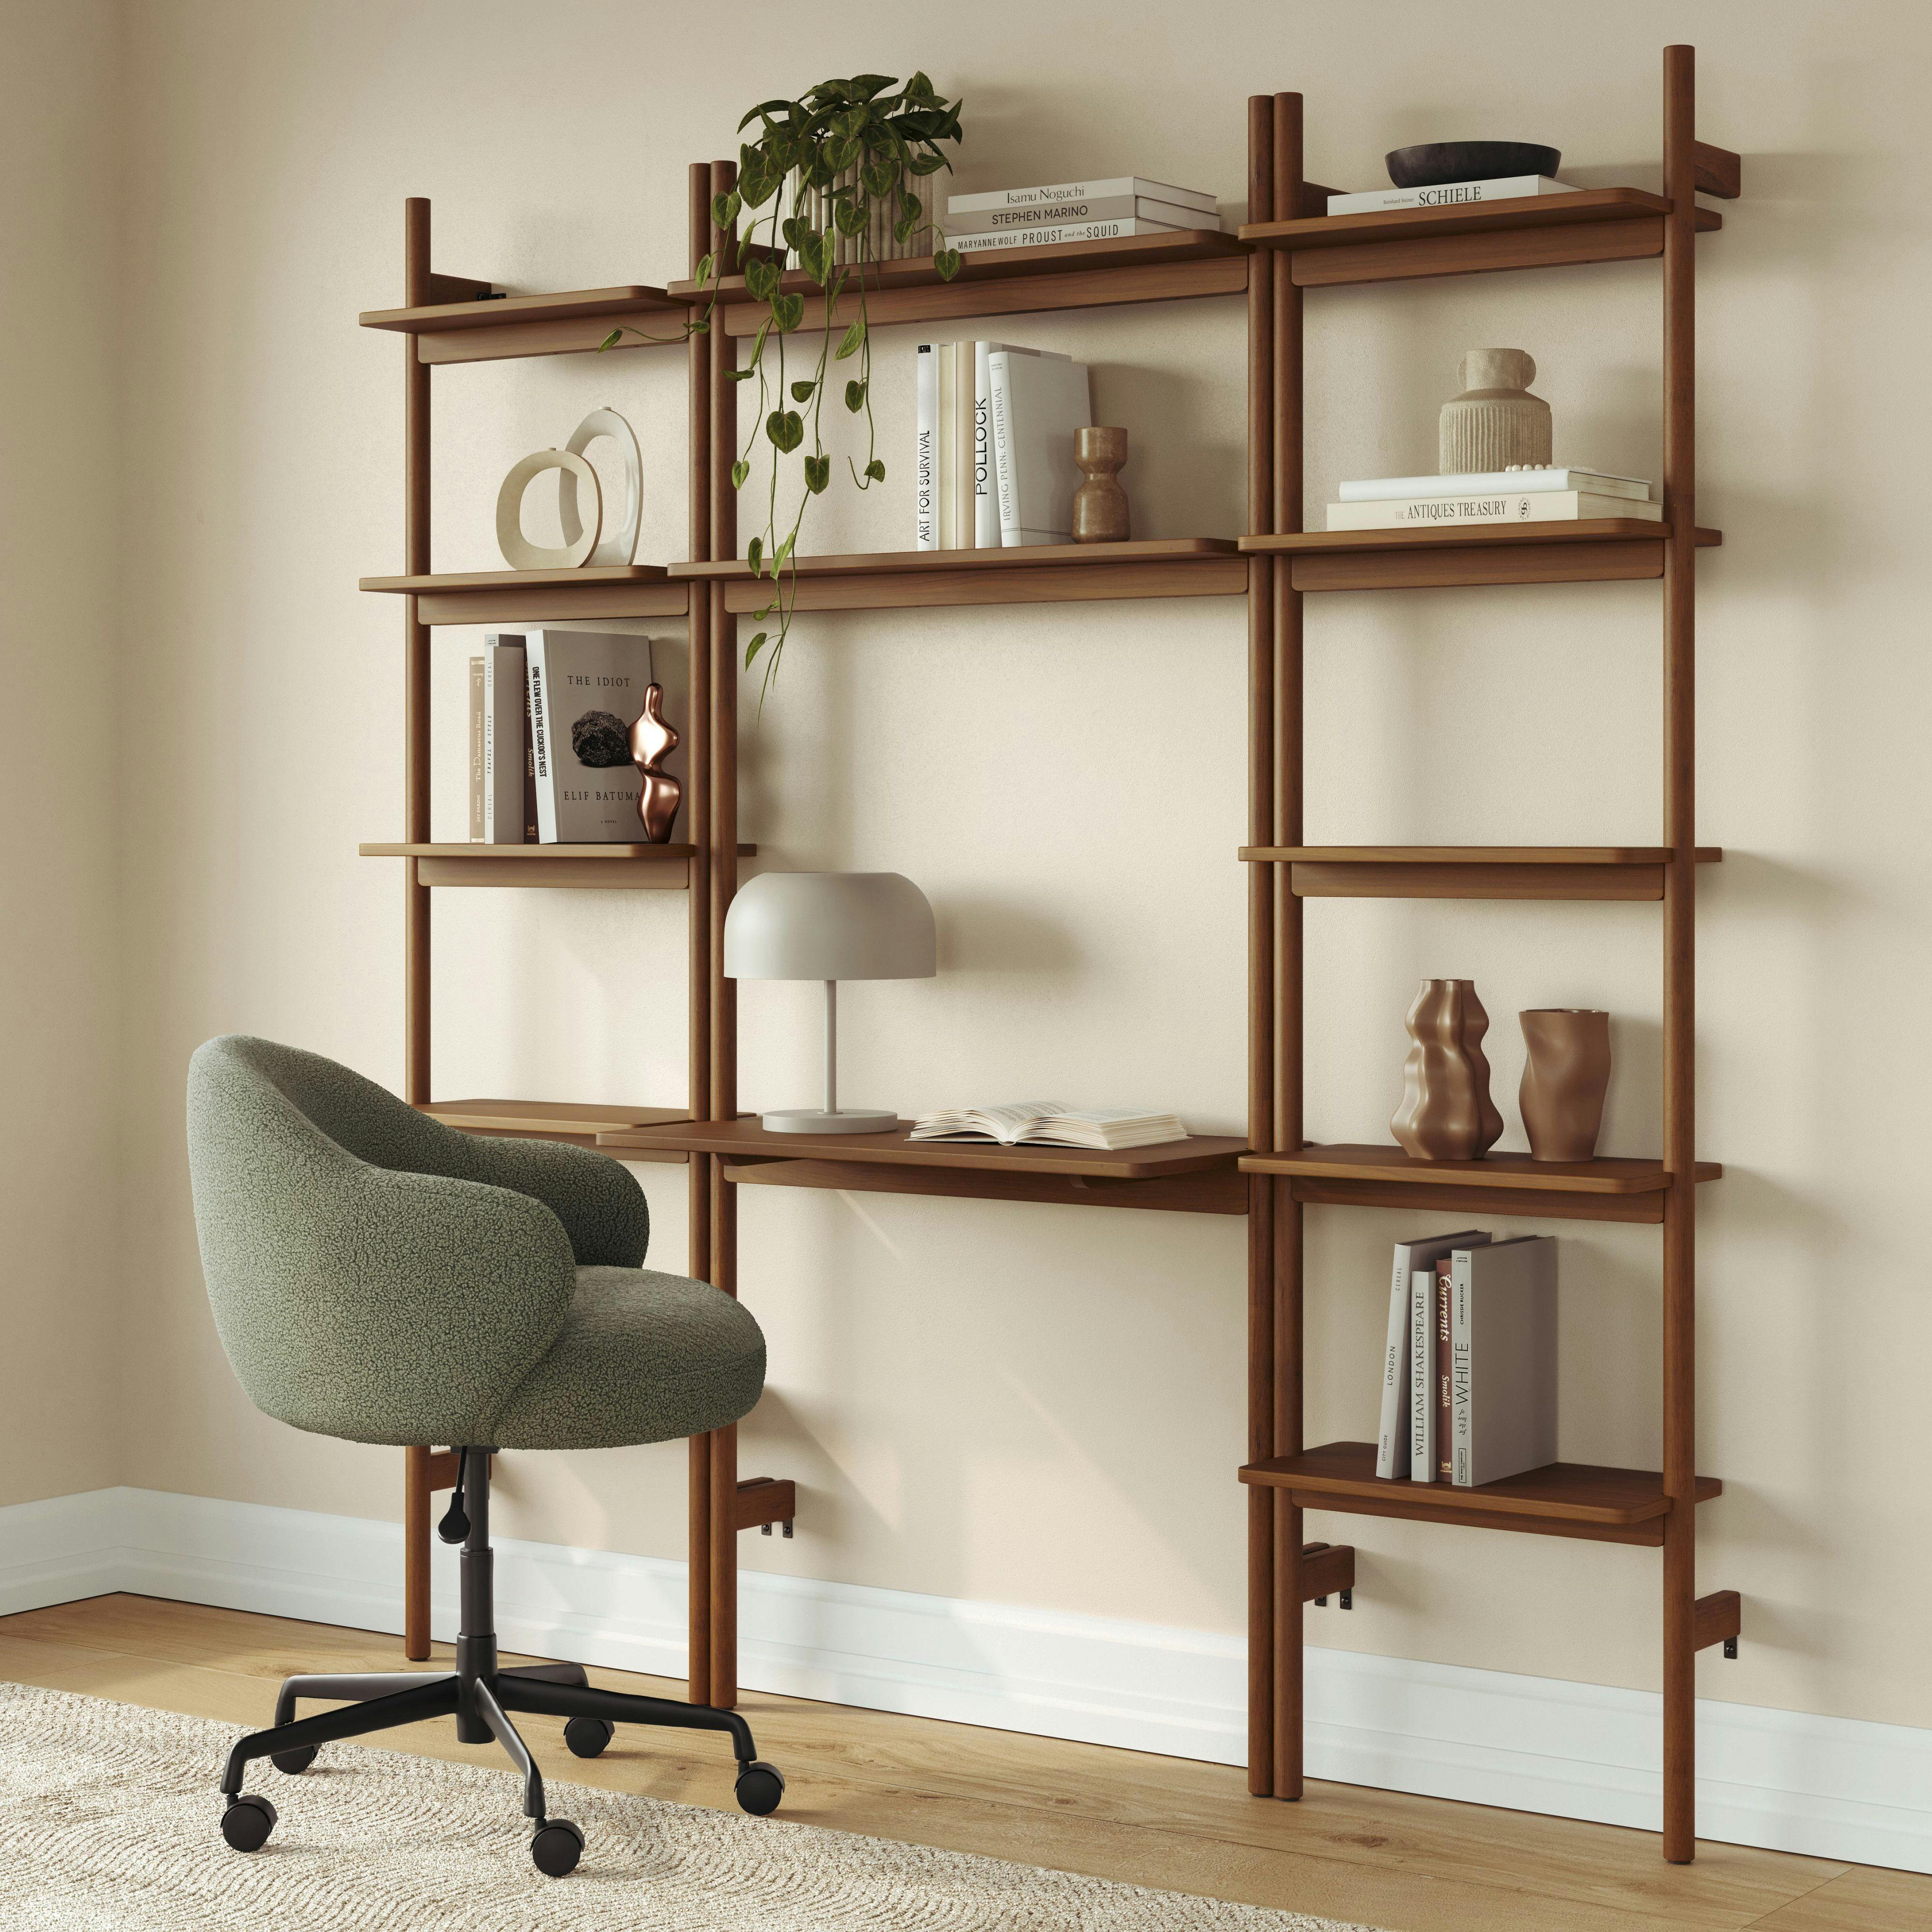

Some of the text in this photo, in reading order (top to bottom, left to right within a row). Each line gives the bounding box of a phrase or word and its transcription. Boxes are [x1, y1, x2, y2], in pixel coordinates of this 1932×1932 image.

[1007, 186, 1084, 204] Isamu Noguchi
[1419, 186, 1481, 206] SCHIELE
[992, 205, 1088, 225] STEPHEN MARINO
[958, 238, 997, 250] MARYANNE
[997, 236, 1018, 246] WOLF
[1023, 229, 1063, 245] PROUST
[1087, 224, 1119, 239] SQUID
[975, 398, 987, 495] POLLOCK
[994, 386, 1010, 521] IRVING PENN: CENTENNIAL
[919, 431, 930, 541] ART FOR SURVIVAL
[1395, 500, 1506, 520] THE ANTIQUES TREASURY
[568, 676, 630, 687] THE IDIOT
[537, 730, 545, 760] CUCKOO'S
[539, 761, 547, 777] NEST
[564, 791, 639, 801] ELIF BATUMA
[1439, 1274, 1452, 1341] Currents
[1387, 1346, 1395, 1386] LONDON
[1416, 1292, 1424, 1456] WILLIAM SHAKESPEARE
[1455, 1342, 1469, 1405] WHITE
